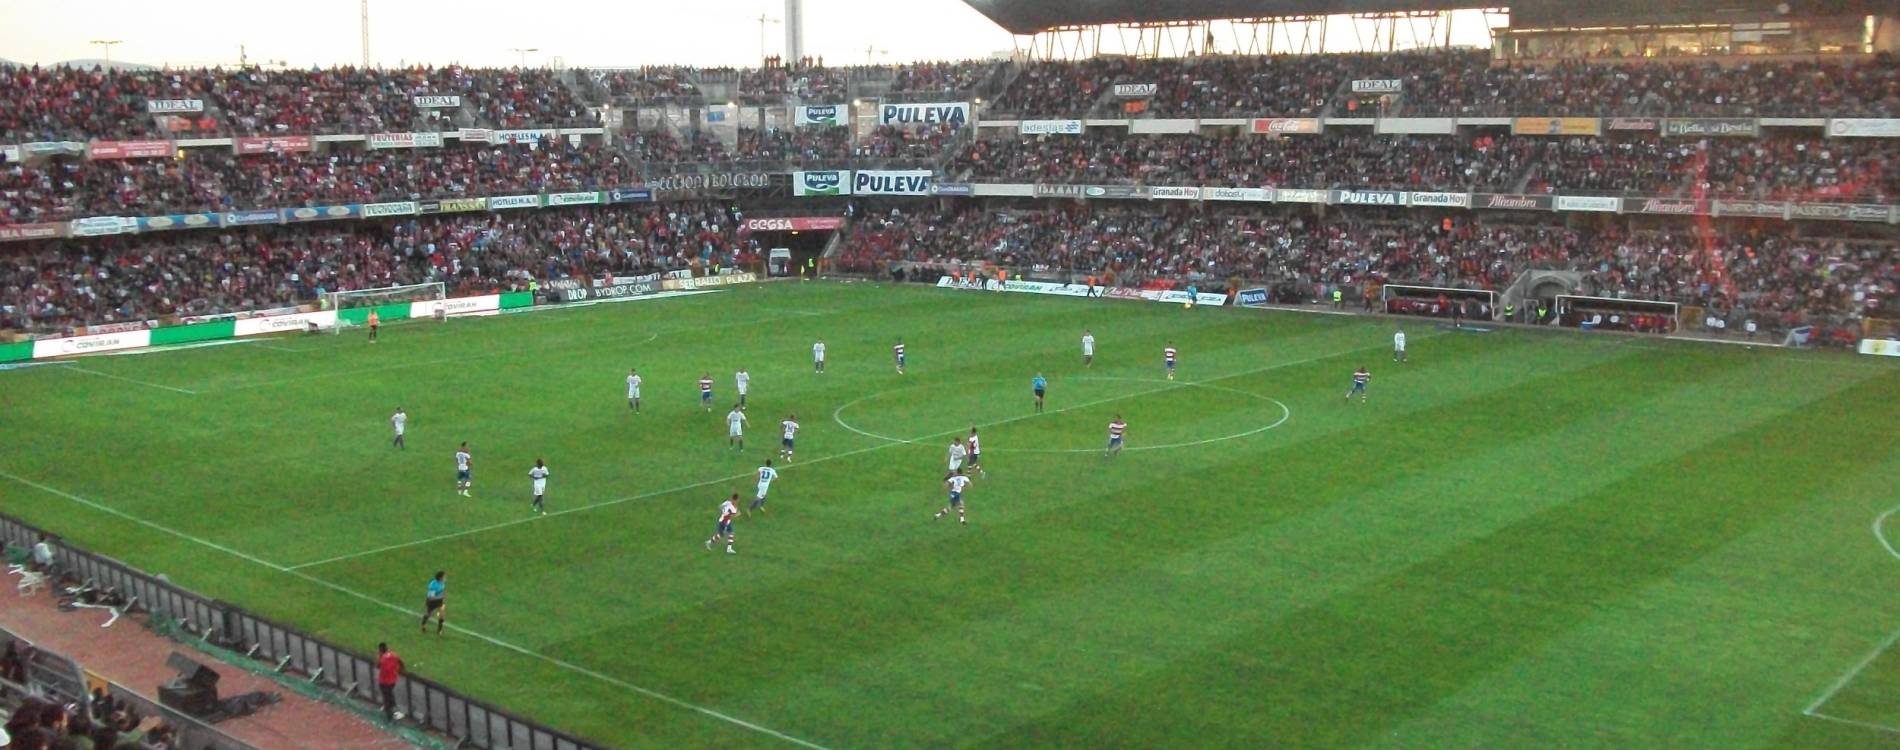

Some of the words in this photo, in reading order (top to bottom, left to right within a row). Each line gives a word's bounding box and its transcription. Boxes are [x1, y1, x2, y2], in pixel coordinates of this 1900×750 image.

[1119, 84, 1150, 94] IDEAL
[420, 96, 454, 105] IDEAL
[808, 107, 835, 115] PULEVA
[883, 105, 965, 124] PULEVA
[806, 174, 837, 182] PULEVA
[856, 173, 930, 192] PULEVA
[1153, 187, 1183, 197] Granada
[1184, 188, 1198, 198] Hoy
[1340, 190, 1395, 204] PULEVA
[1413, 193, 1448, 203] Granada
[1449, 194, 1467, 205] Hoy
[1488, 194, 1537, 208] Alhambra
[726, 271, 756, 284] PLAZA
